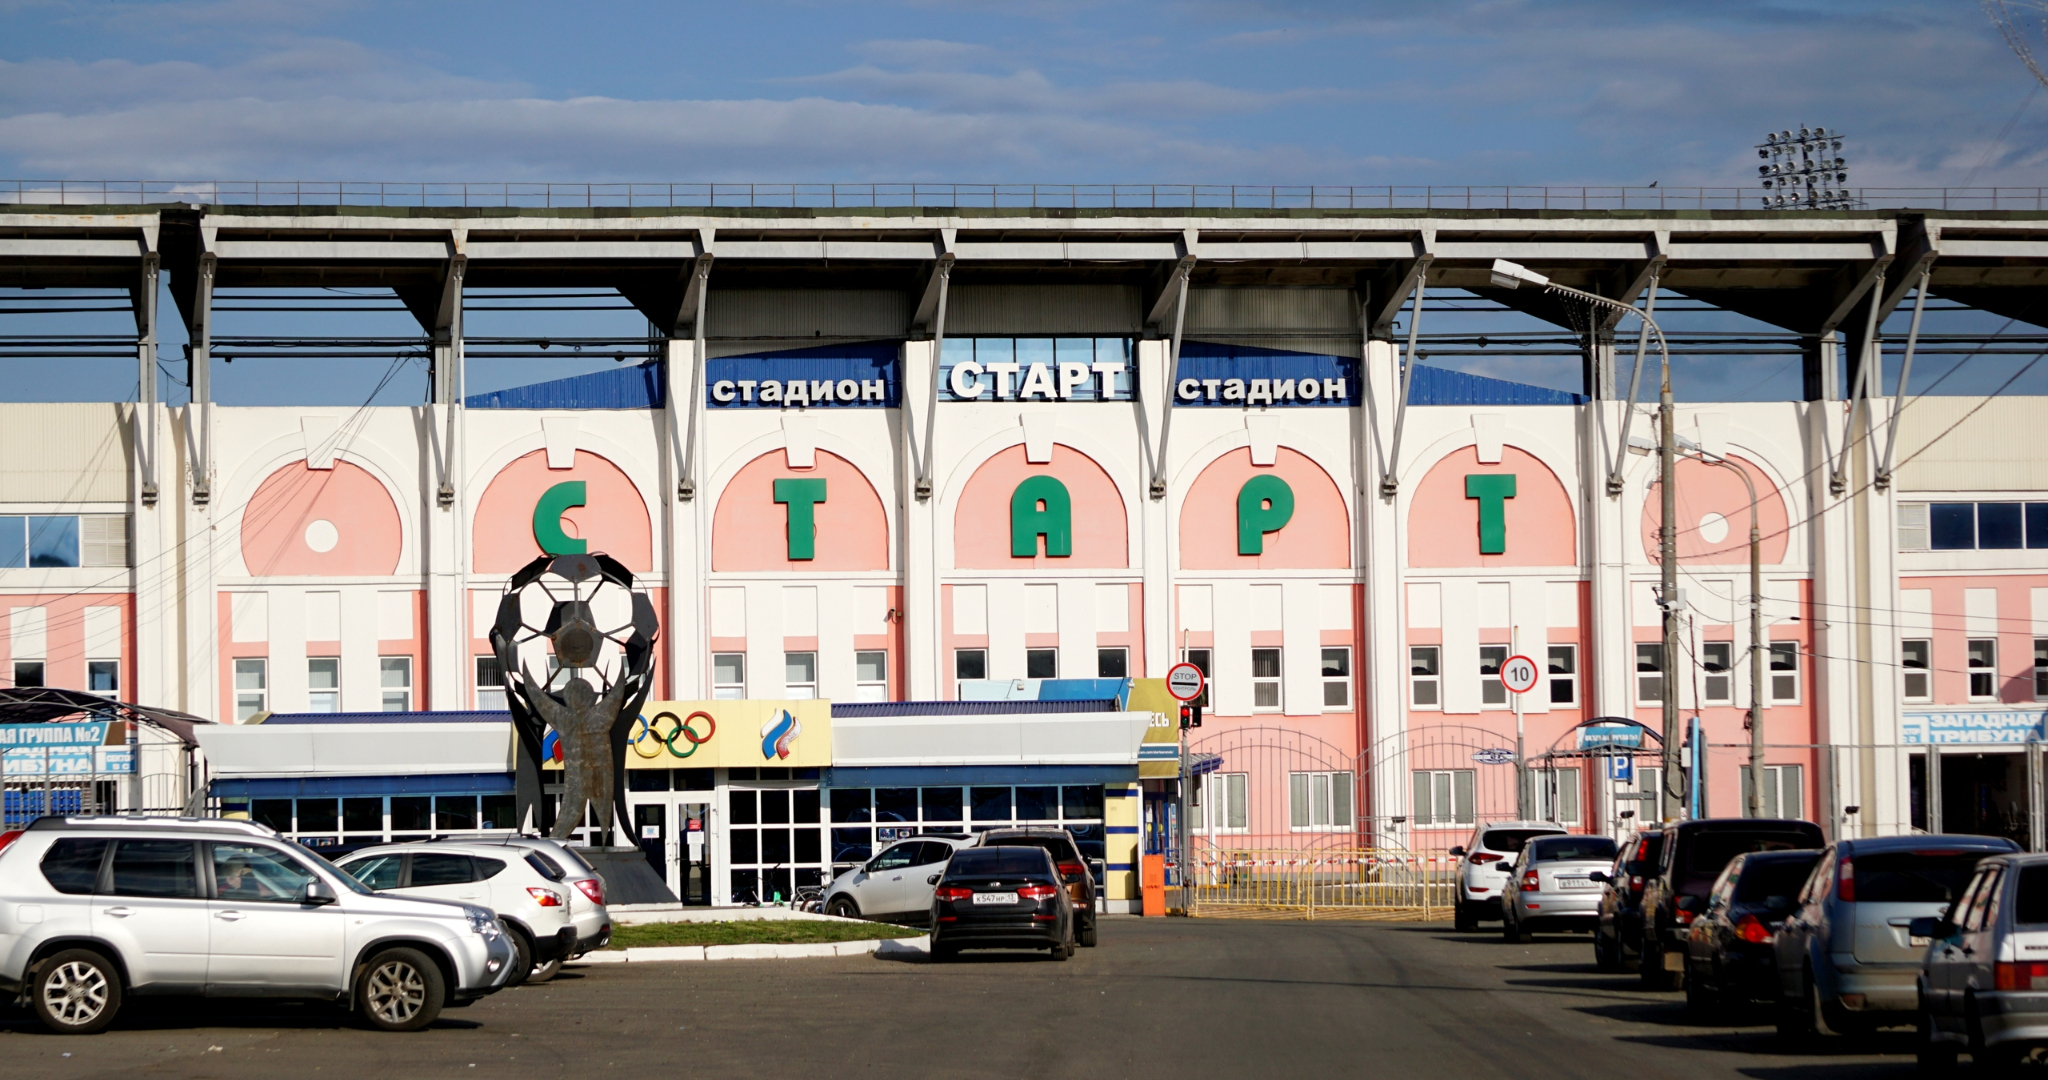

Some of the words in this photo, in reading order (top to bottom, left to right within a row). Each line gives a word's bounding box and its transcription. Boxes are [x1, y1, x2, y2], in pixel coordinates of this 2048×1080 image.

[950, 361, 1125, 398] СТАРТ
[712, 379, 885, 406] стадион
[1178, 378, 1346, 405] стадион
[1173, 672, 1197, 681] STOP
[1510, 666, 1529, 682] 10
[1930, 713, 2042, 729] ЗАПАДНАЯ
[18, 727, 73, 743] ГРУППА
[1930, 728, 2044, 742] ТРИБУНА
[1614, 756, 1628, 776] P
